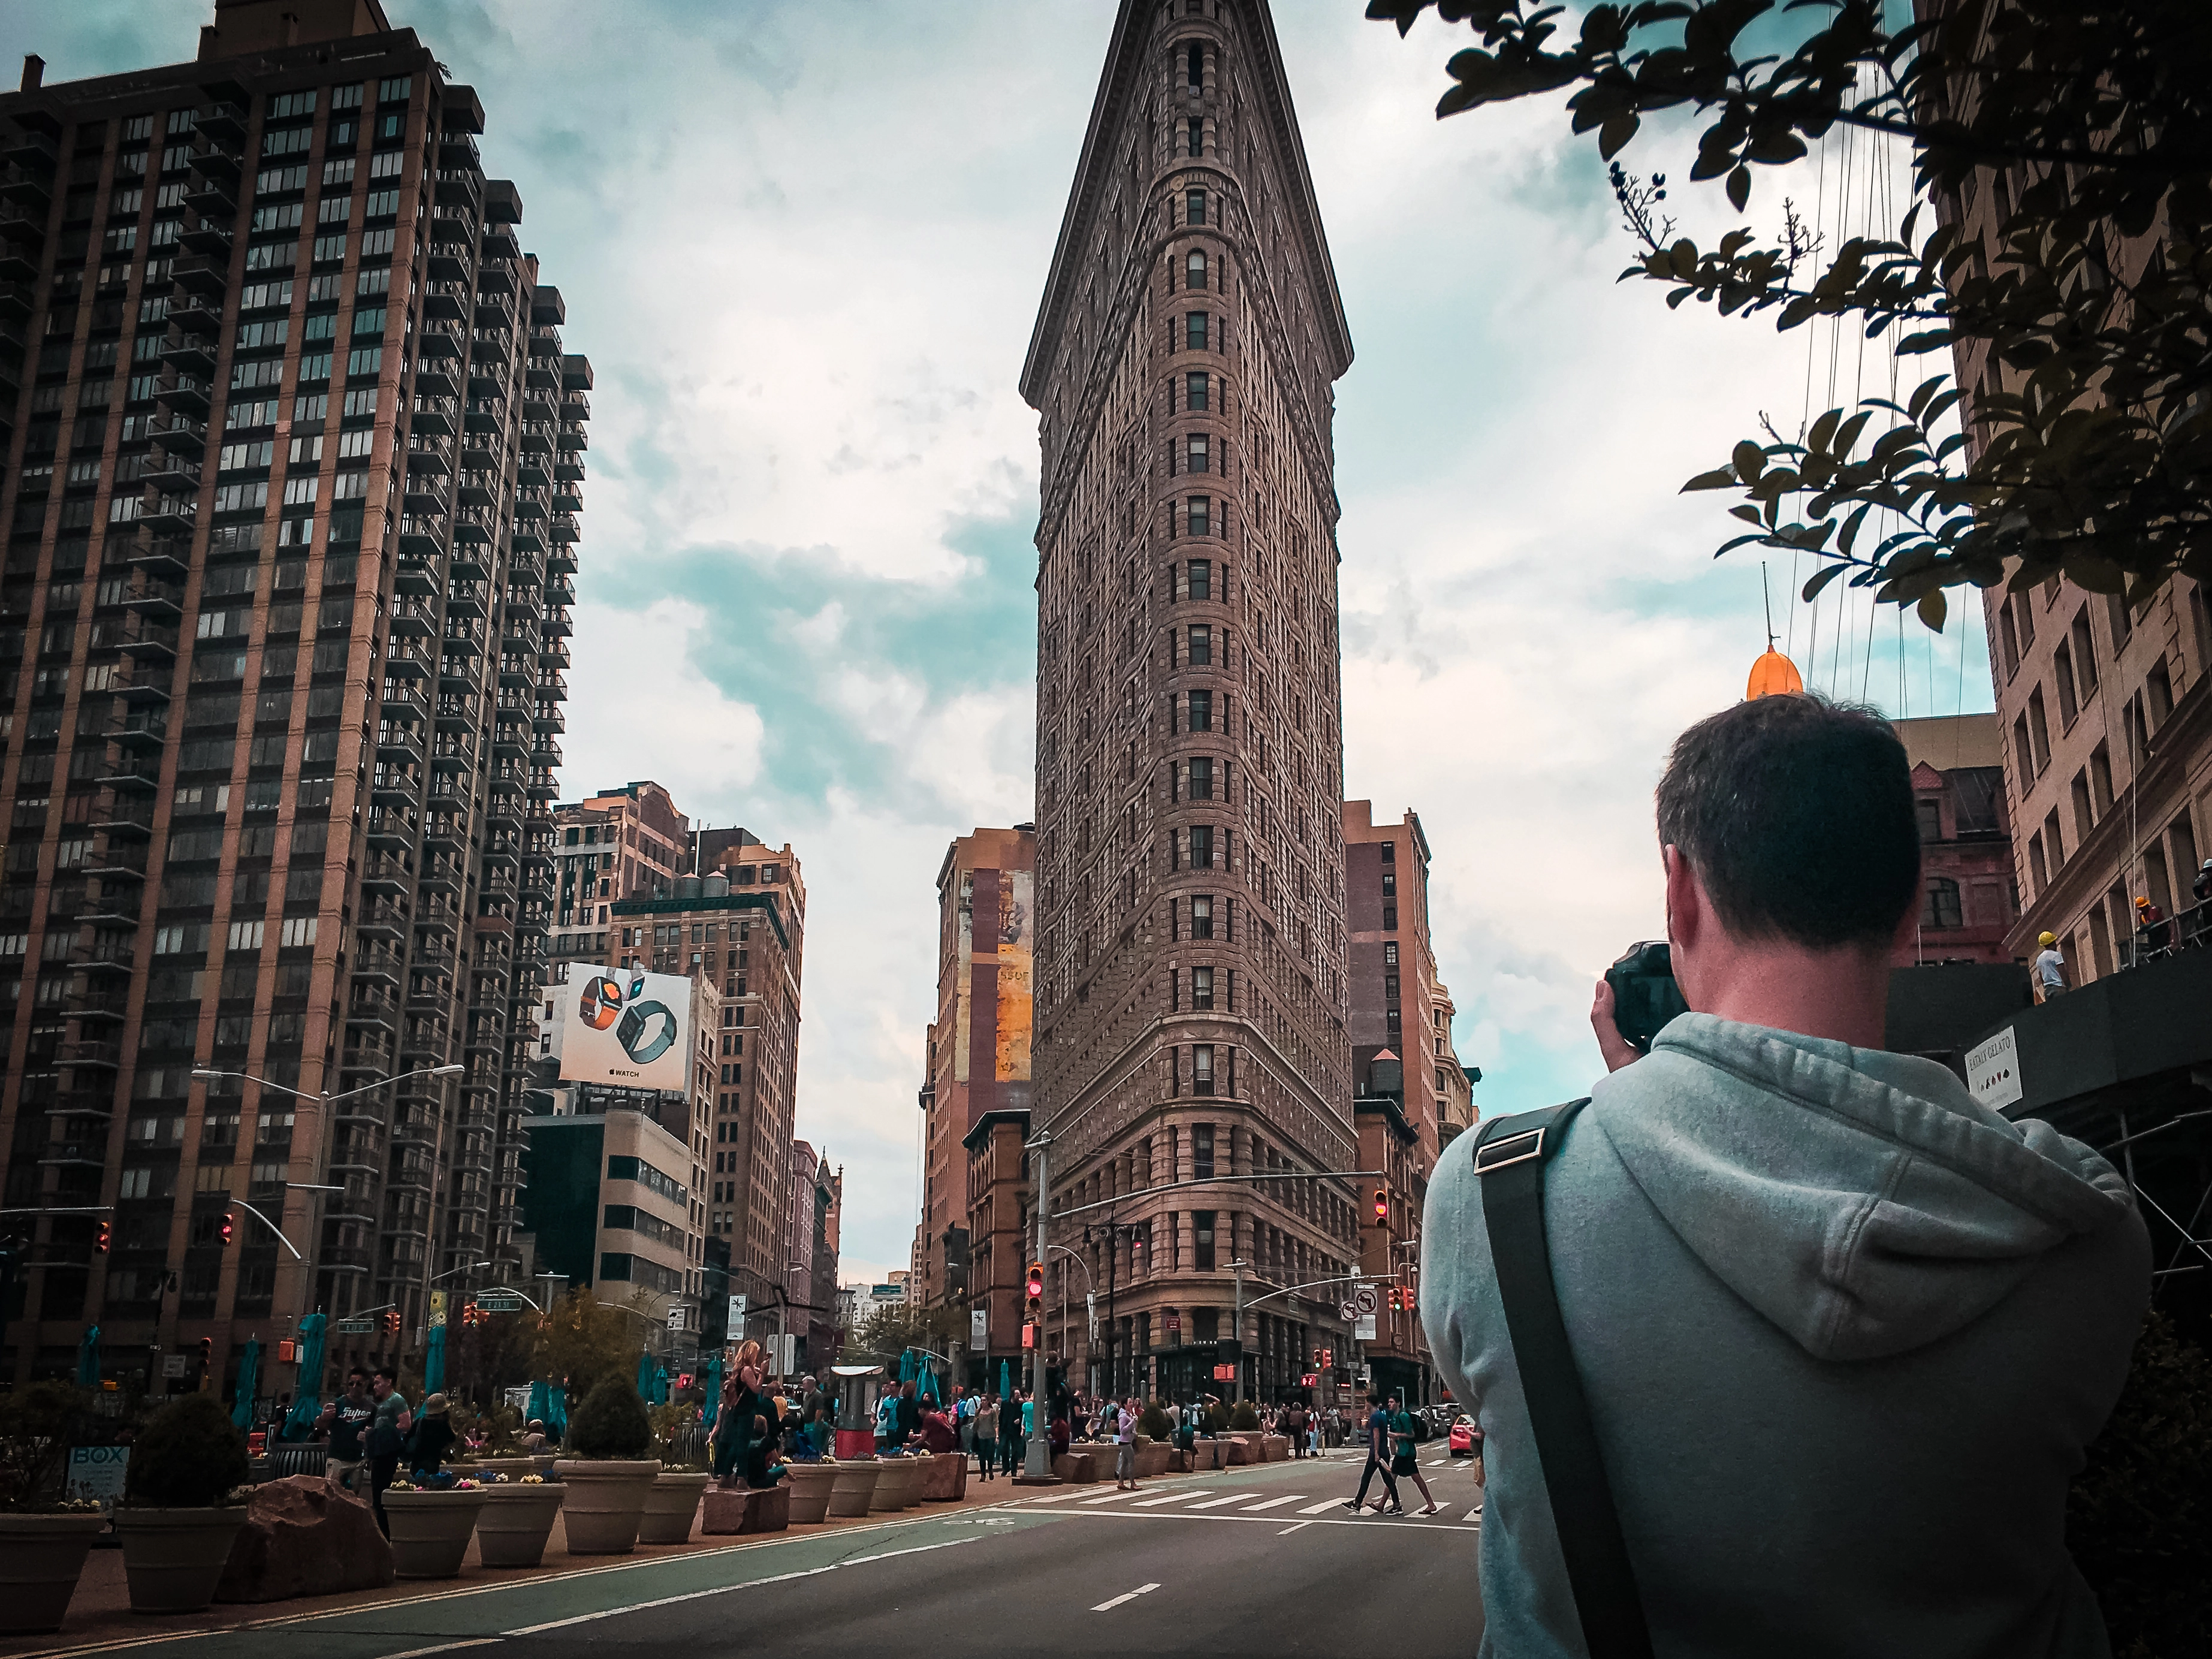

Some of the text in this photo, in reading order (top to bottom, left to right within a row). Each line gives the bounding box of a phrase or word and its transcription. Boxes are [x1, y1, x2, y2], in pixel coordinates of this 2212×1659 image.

[1987, 1036, 2011, 1059] GELATO
[615, 1069, 639, 1078] WATCH
[73, 1446, 125, 1464] BOX
